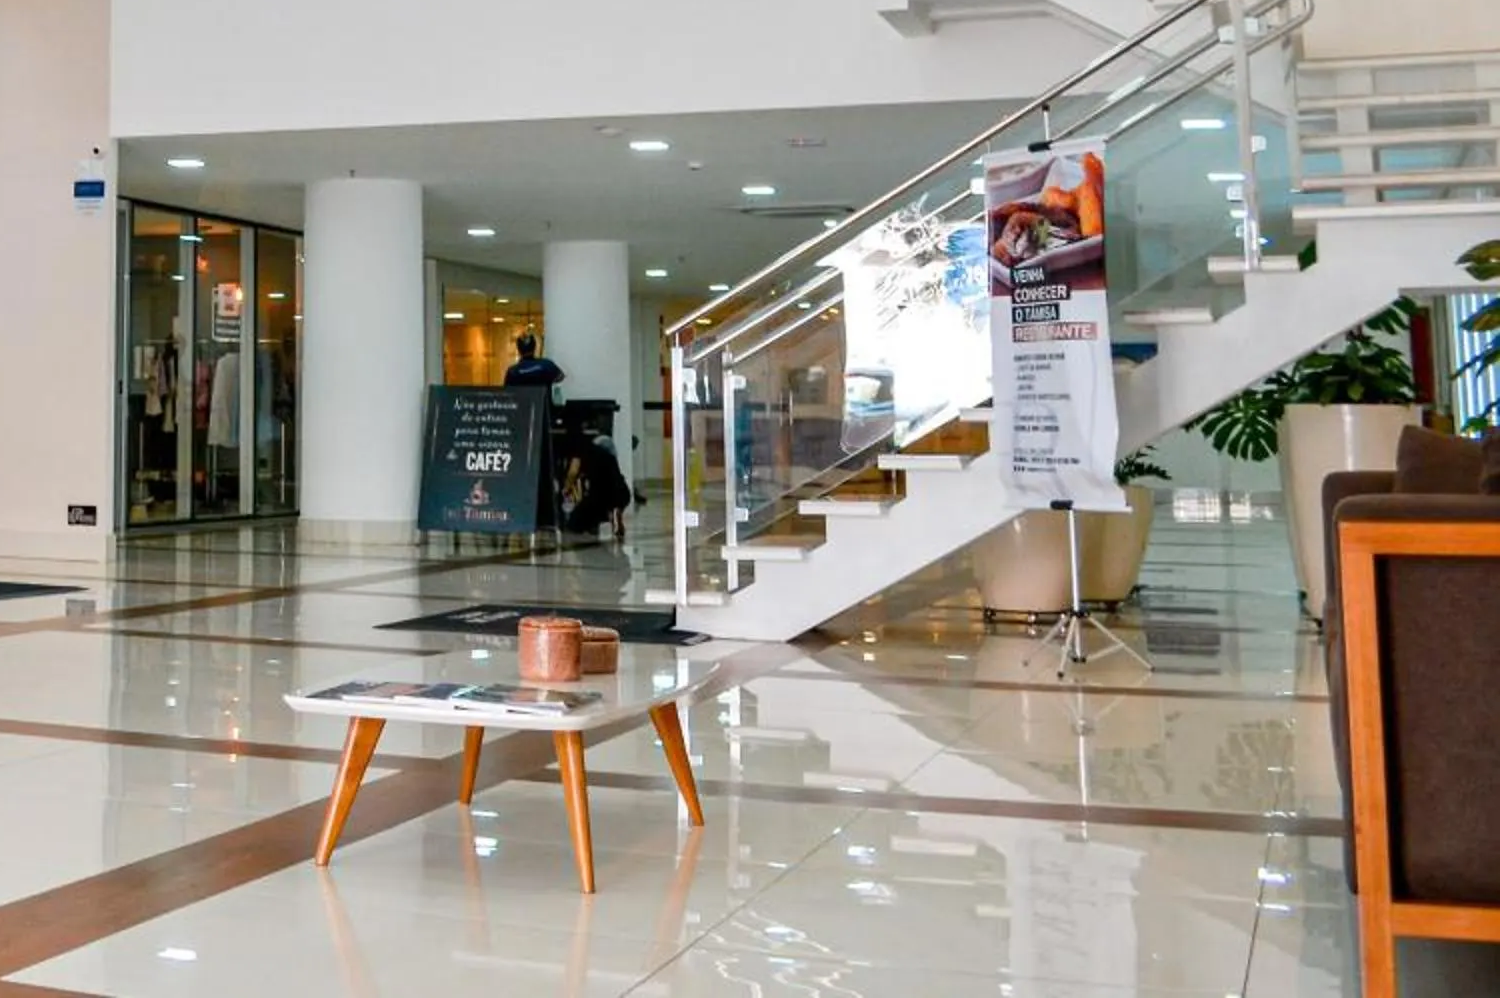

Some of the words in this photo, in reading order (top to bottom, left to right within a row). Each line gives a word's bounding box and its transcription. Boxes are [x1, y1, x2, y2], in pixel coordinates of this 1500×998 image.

[1013, 267, 1045, 284] VENHA
[1013, 284, 1067, 303] CONHECER
[1015, 308, 1024, 323] O
[465, 448, 512, 473] CAFÉ?
